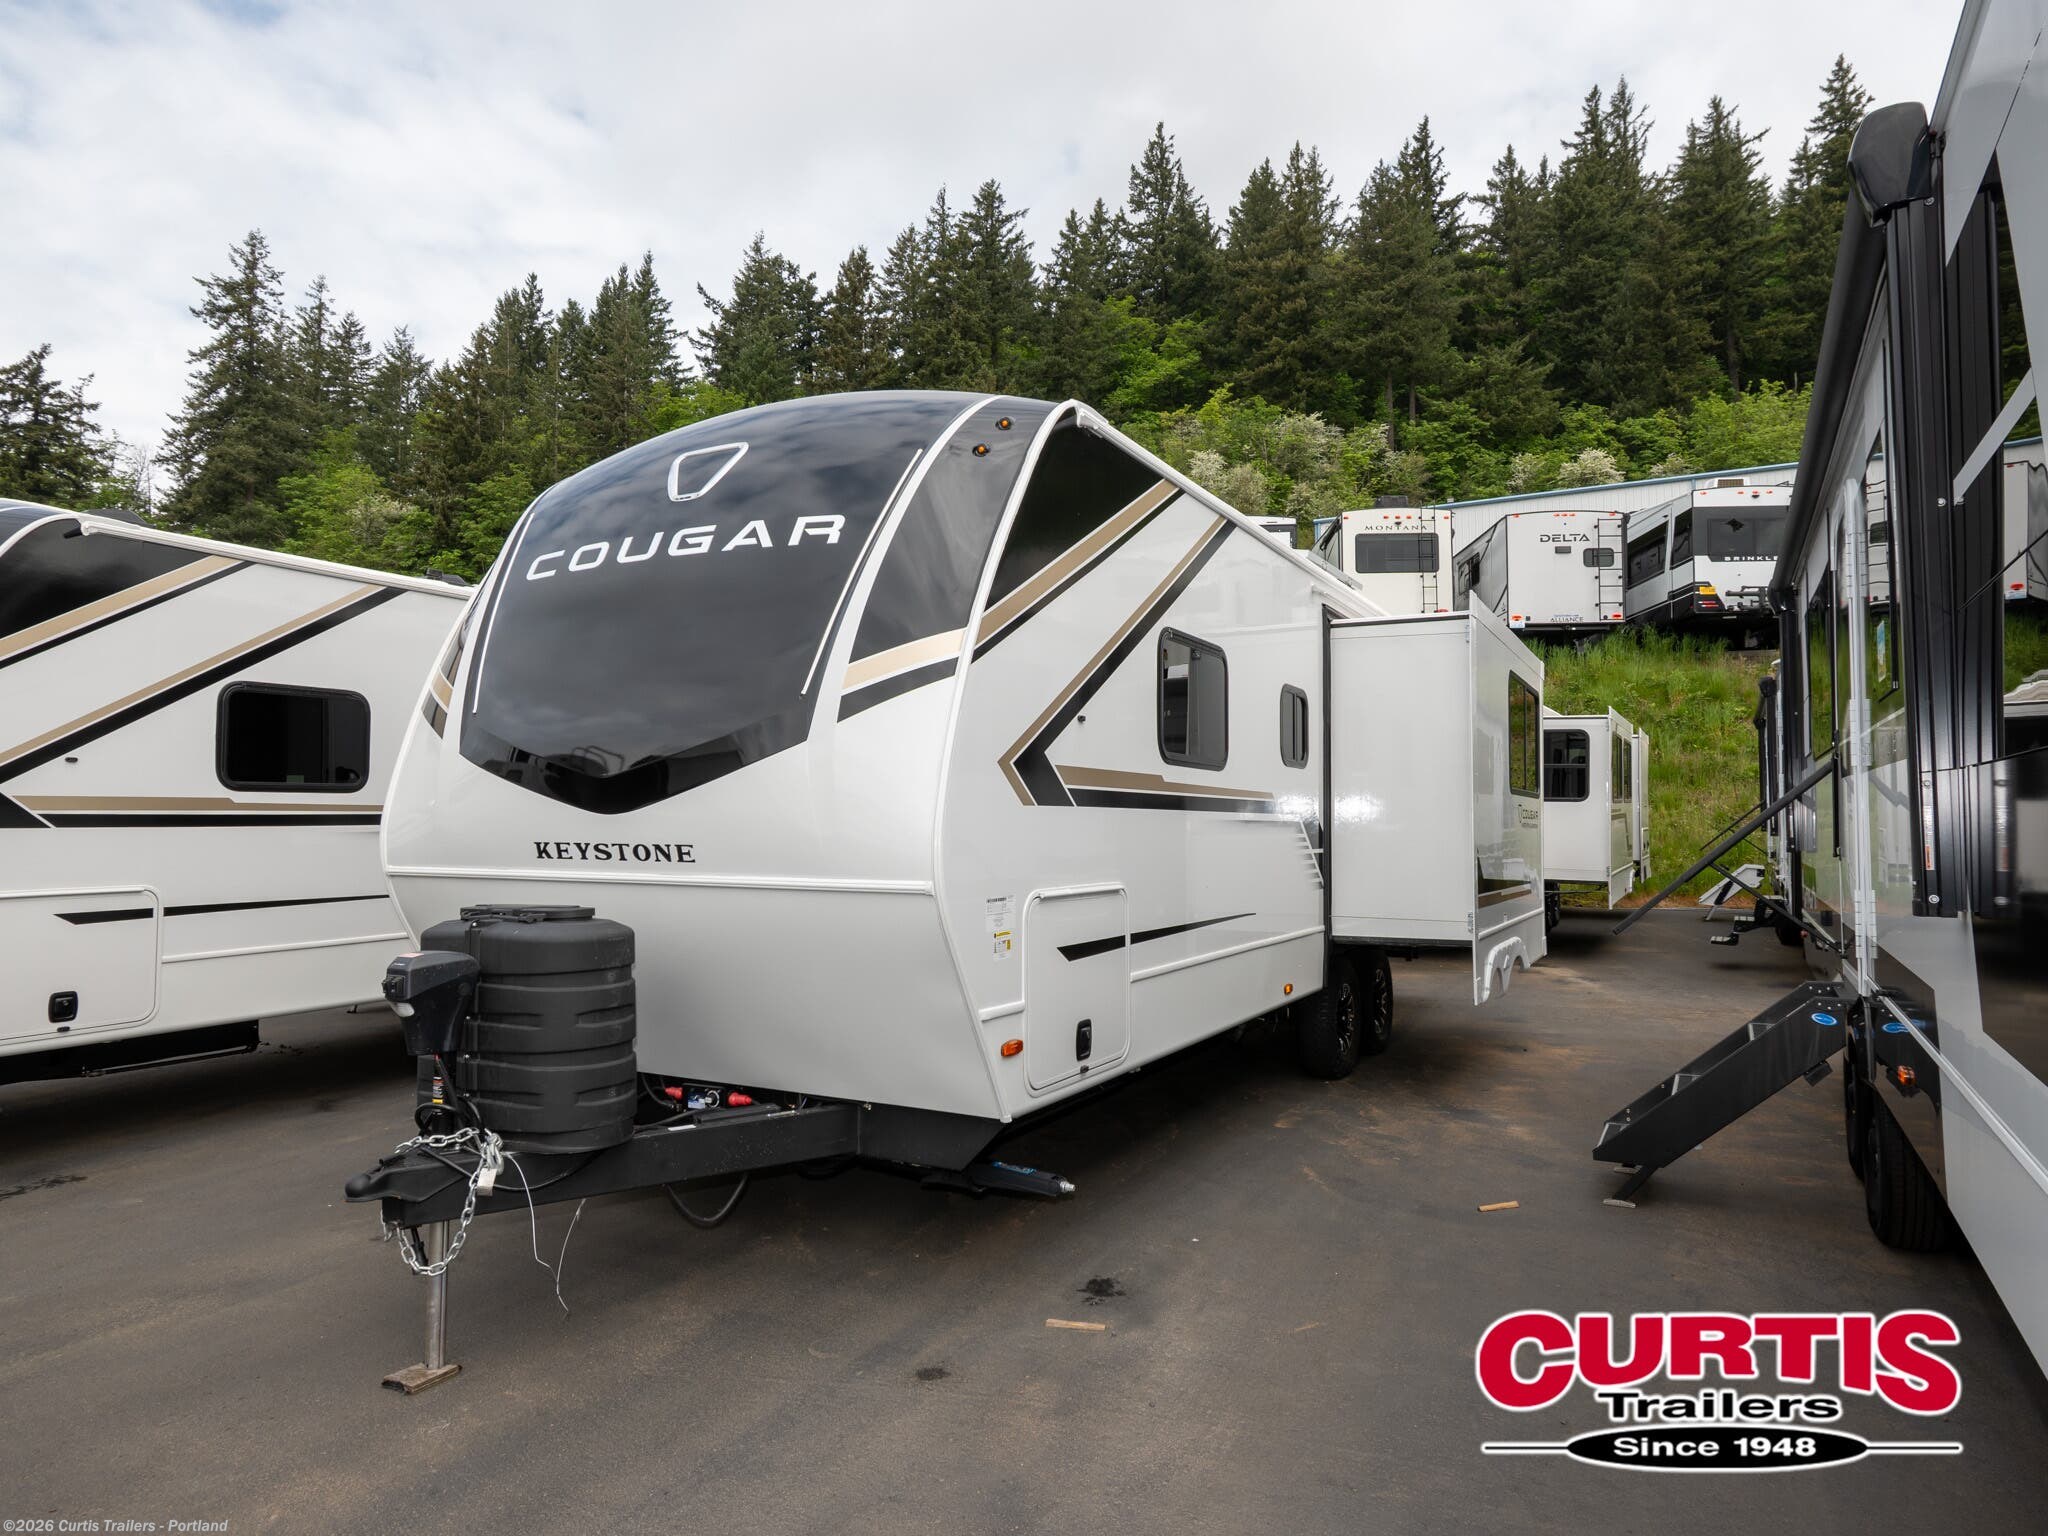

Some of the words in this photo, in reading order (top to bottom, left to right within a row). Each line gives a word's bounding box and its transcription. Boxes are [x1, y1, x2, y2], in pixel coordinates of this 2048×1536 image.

[526, 514, 845, 580] COUGAR
[1540, 533, 1590, 543] DELTA
[534, 842, 696, 863] KEYSTONE
